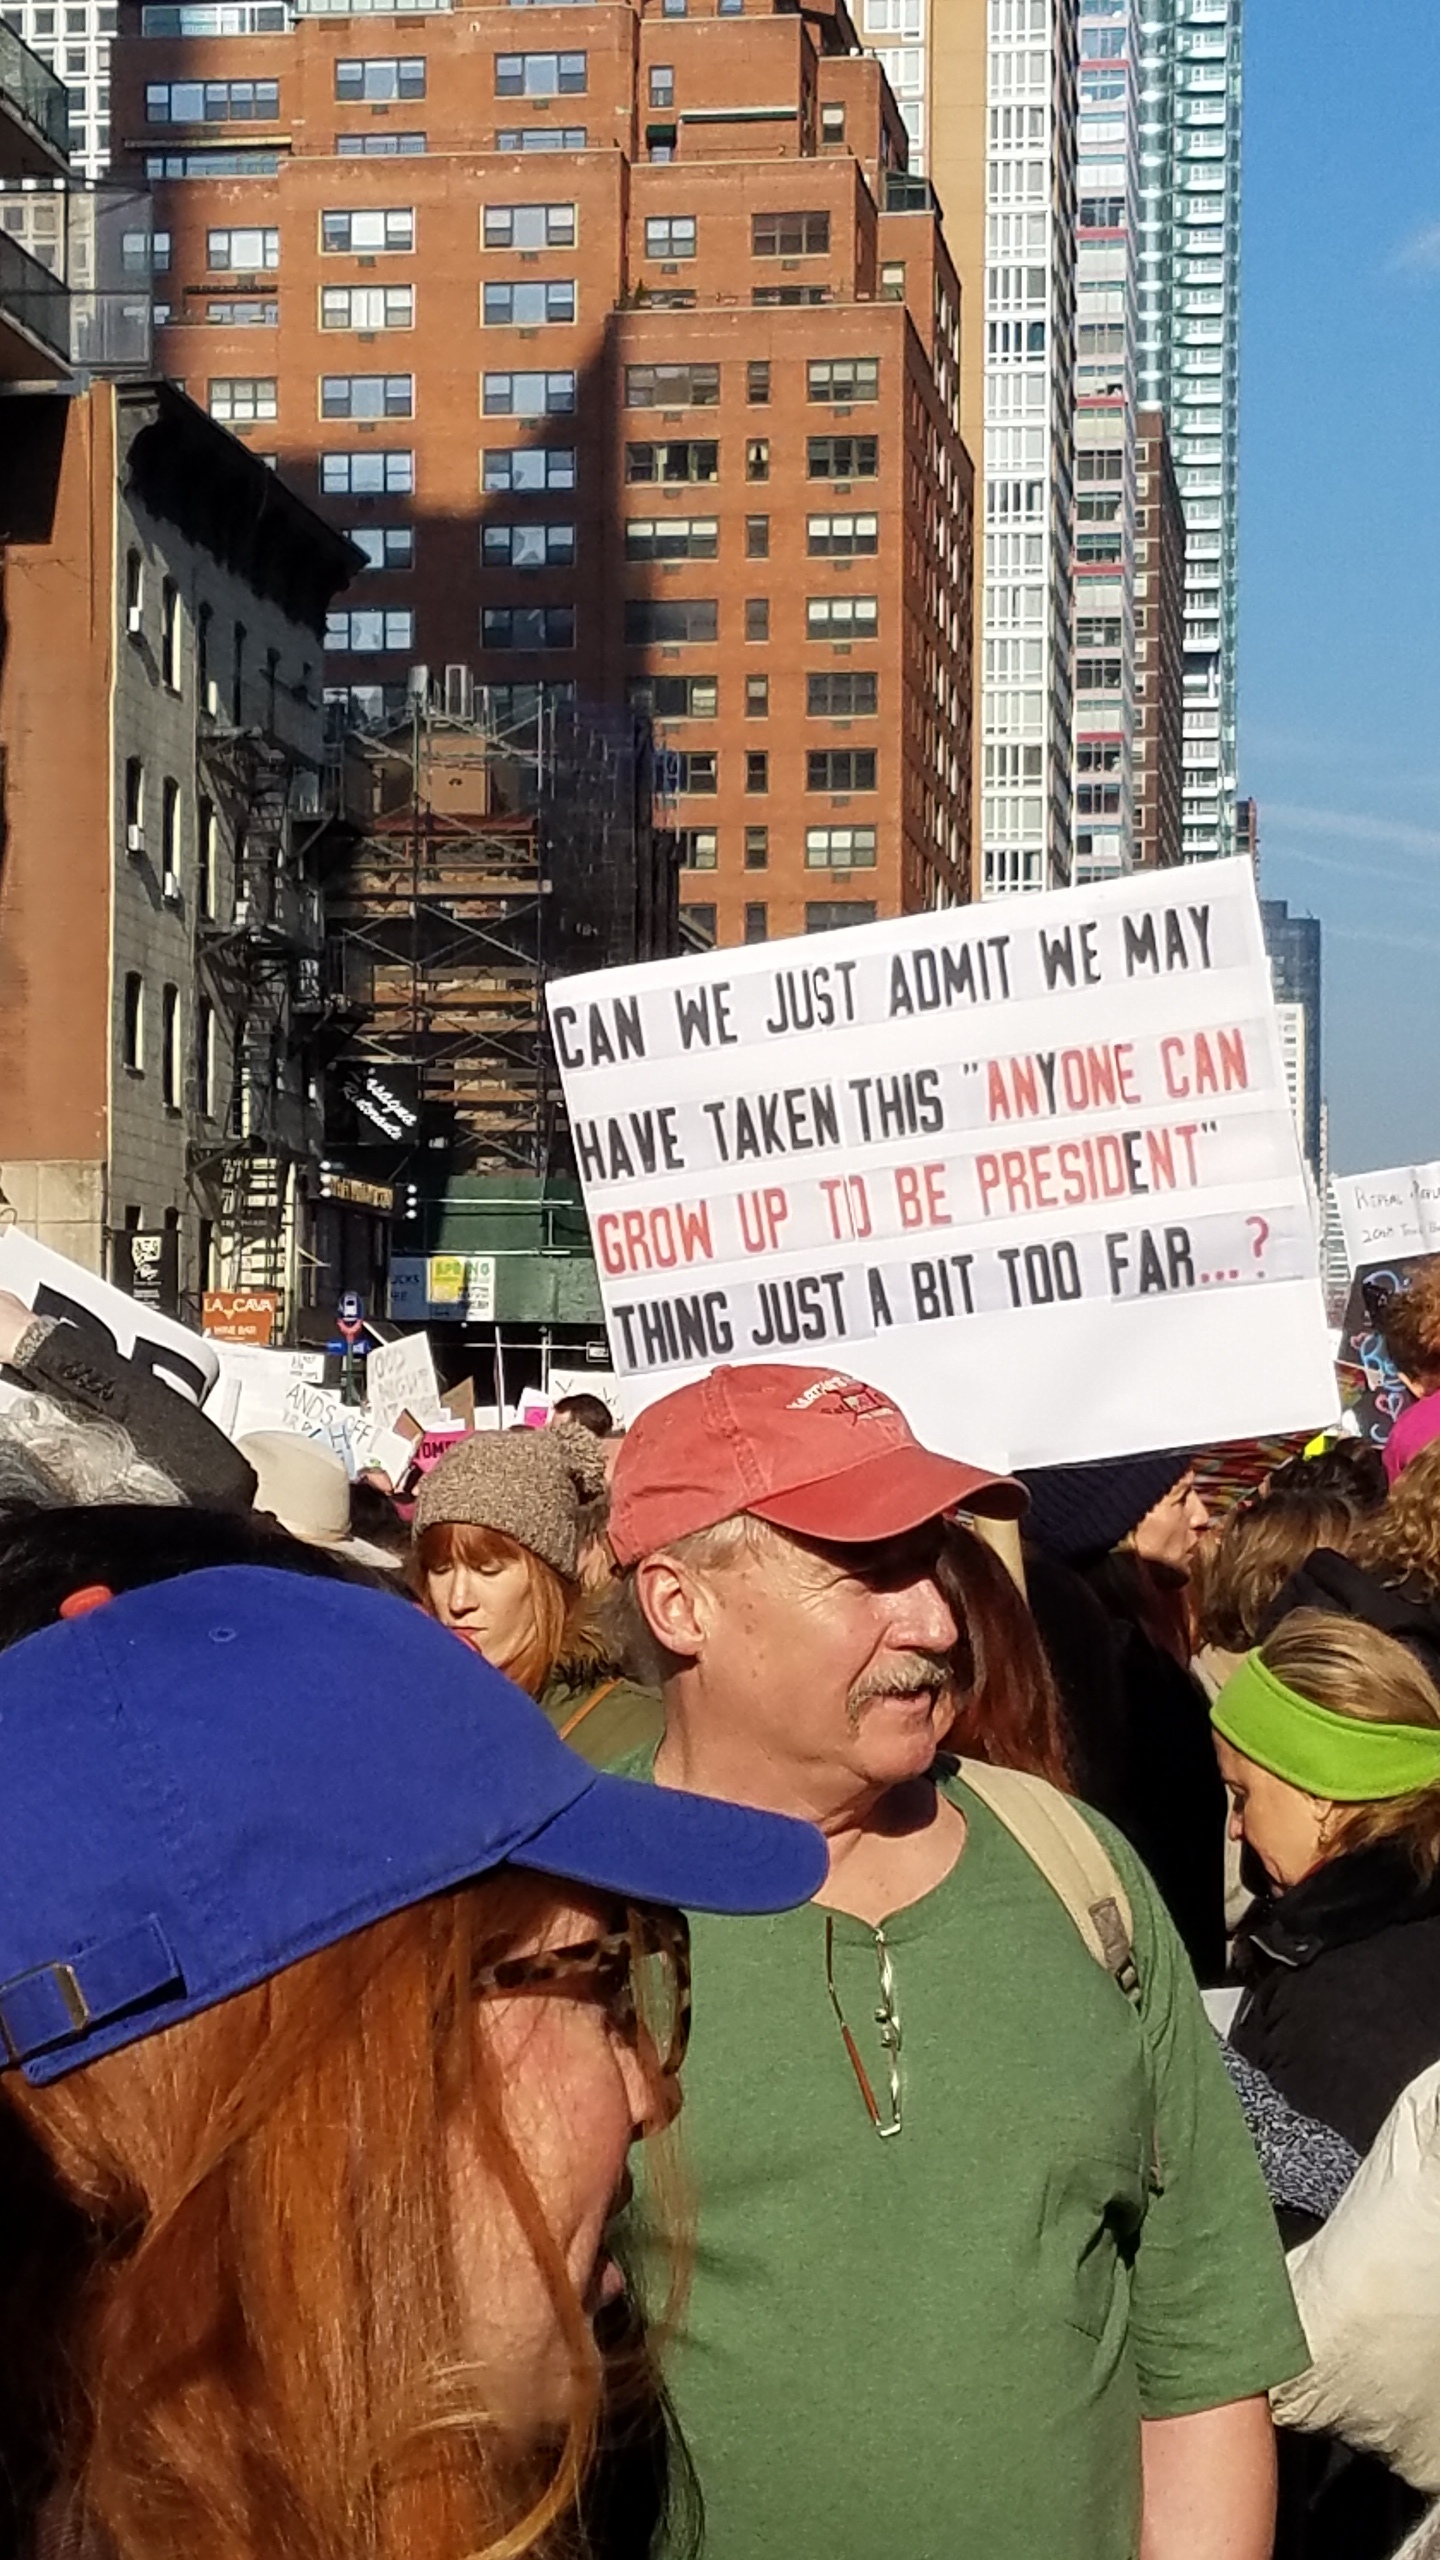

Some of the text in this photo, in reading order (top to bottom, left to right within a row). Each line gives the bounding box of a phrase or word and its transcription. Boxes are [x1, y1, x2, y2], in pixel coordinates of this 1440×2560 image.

[555, 905, 1210, 1068] CAN WE JUST ADMIT WE MAY
[575, 1033, 1247, 1182] HAVE TAKEN THIS "ANYONE CAN
[598, 1122, 1217, 1274] GROW UP TO BE PRESIDENT"
[204, 1298, 273, 1313] LA CAVA
[213, 1325, 257, 1336] WINE BAR
[612, 1292, 734, 1363] THING
[753, 1272, 846, 1345] JUST
[868, 1268, 894, 1328] A
[912, 1255, 974, 1322] BIT
[998, 1241, 1082, 1308] TOO
